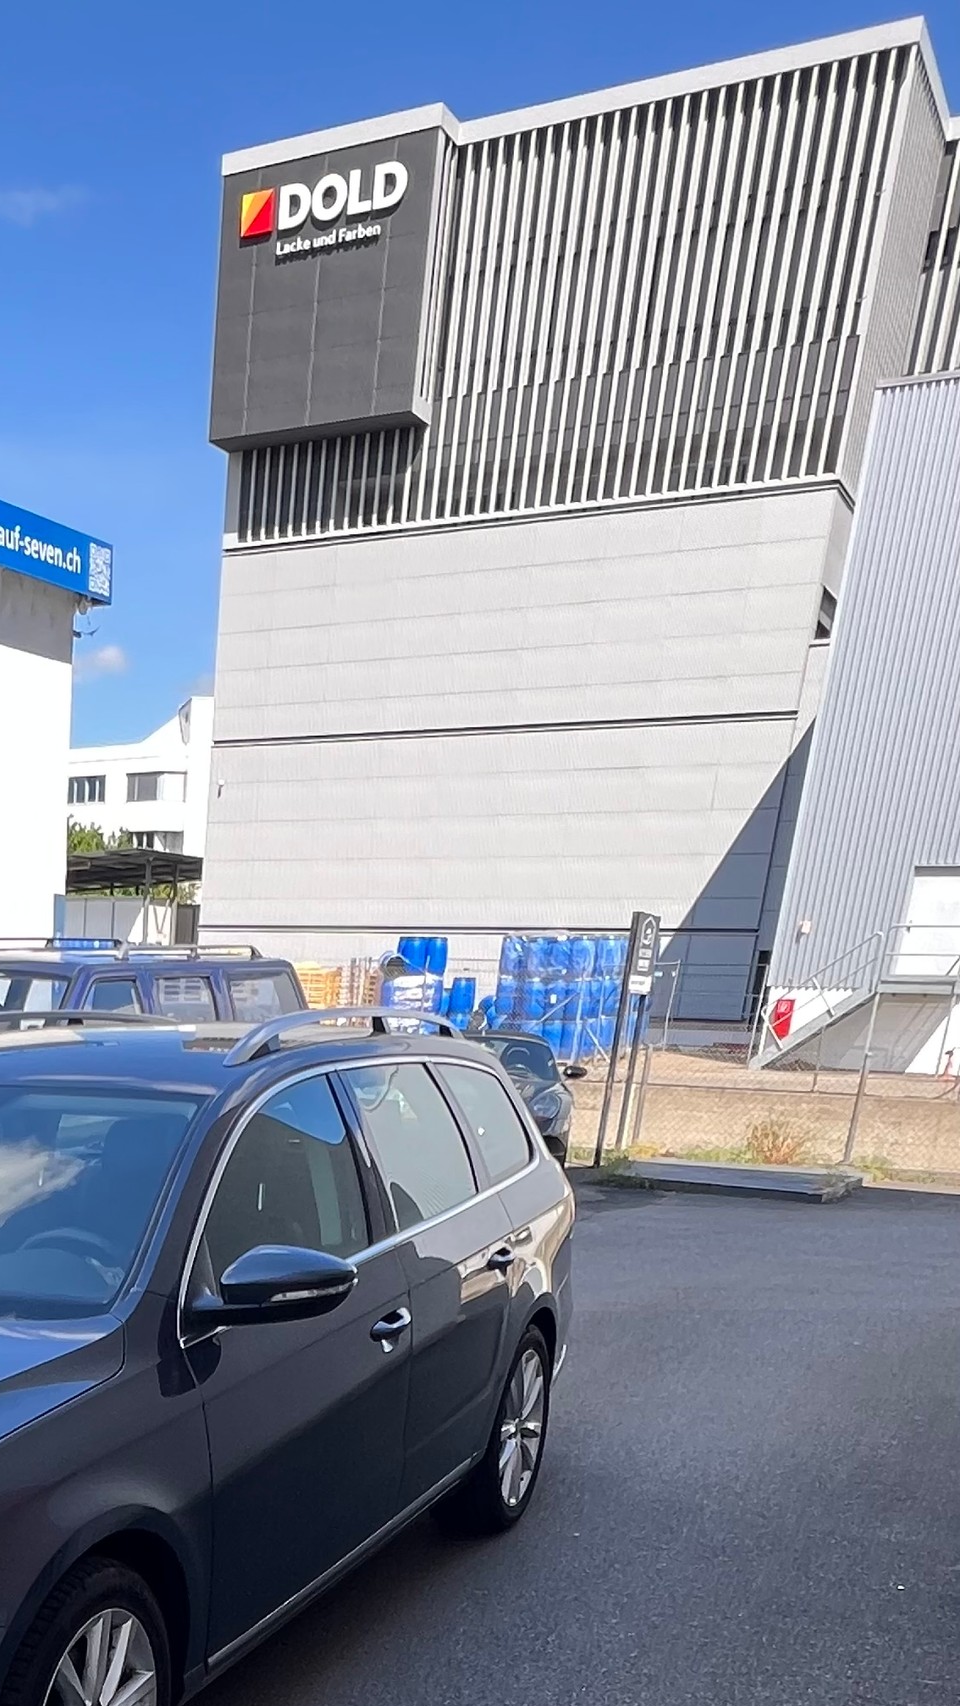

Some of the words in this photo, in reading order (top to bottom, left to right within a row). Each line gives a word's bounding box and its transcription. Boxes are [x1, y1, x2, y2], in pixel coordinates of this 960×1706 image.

[277, 160, 409, 231] DOLD
[275, 236, 312, 256] Lacke
[312, 229, 337, 248] und
[338, 223, 382, 243] Farben
